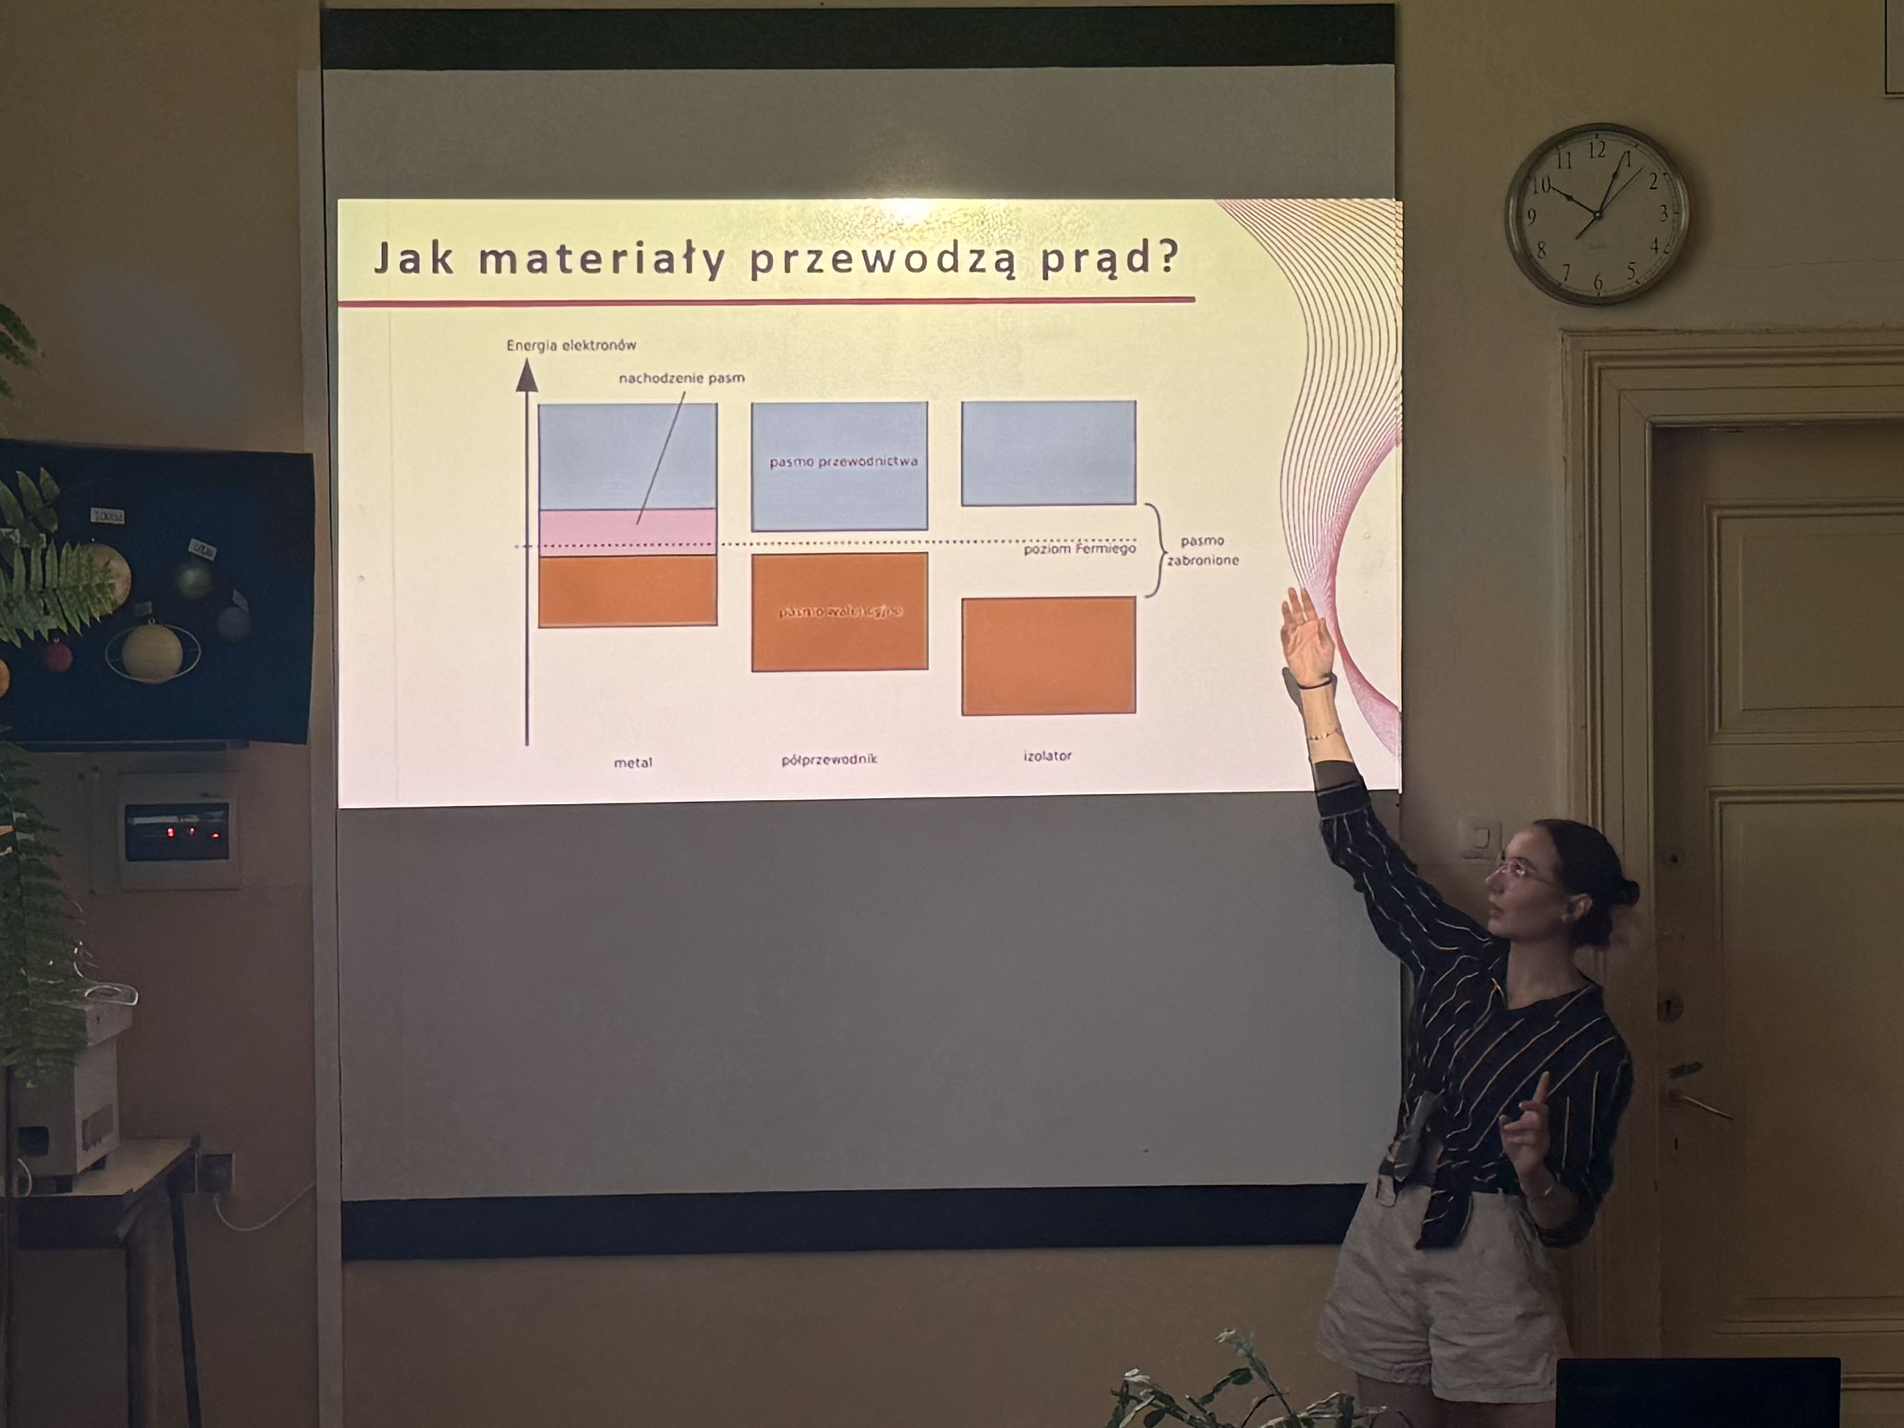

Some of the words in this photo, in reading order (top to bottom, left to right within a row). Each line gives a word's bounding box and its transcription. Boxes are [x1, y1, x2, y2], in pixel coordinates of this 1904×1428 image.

[1589, 139, 1606, 159] 12
[1556, 151, 1572, 170] 11
[1533, 175, 1551, 195] 10
[1649, 172, 1658, 190] 2
[1527, 208, 1537, 226] 9
[1659, 204, 1669, 222] 3
[1537, 240, 1547, 259] 8
[1650, 237, 1659, 254] 4
[374, 239, 454, 275] Jak
[480, 238, 726, 282] materiały
[750, 238, 1016, 282] przewodzą
[1041, 237, 1180, 281] prąd?
[1562, 263, 1571, 282] 7
[1627, 261, 1636, 280] 5
[1593, 272, 1604, 291] 6
[506, 339, 558, 354] Energia
[562, 338, 637, 352] elektronów
[619, 372, 704, 385] nachodzenie
[708, 374, 746, 386] pasm
[769, 457, 814, 470] pasmo
[818, 454, 919, 469] przewodnictwa
[1024, 542, 1071, 556] poziom
[1075, 541, 1137, 556] Fermiego
[1180, 536, 1225, 548] pasmo
[1167, 554, 1240, 567] zabronione
[614, 757, 653, 768] metal
[781, 752, 879, 767] półprzewodnik
[1023, 749, 1073, 763] izolator
